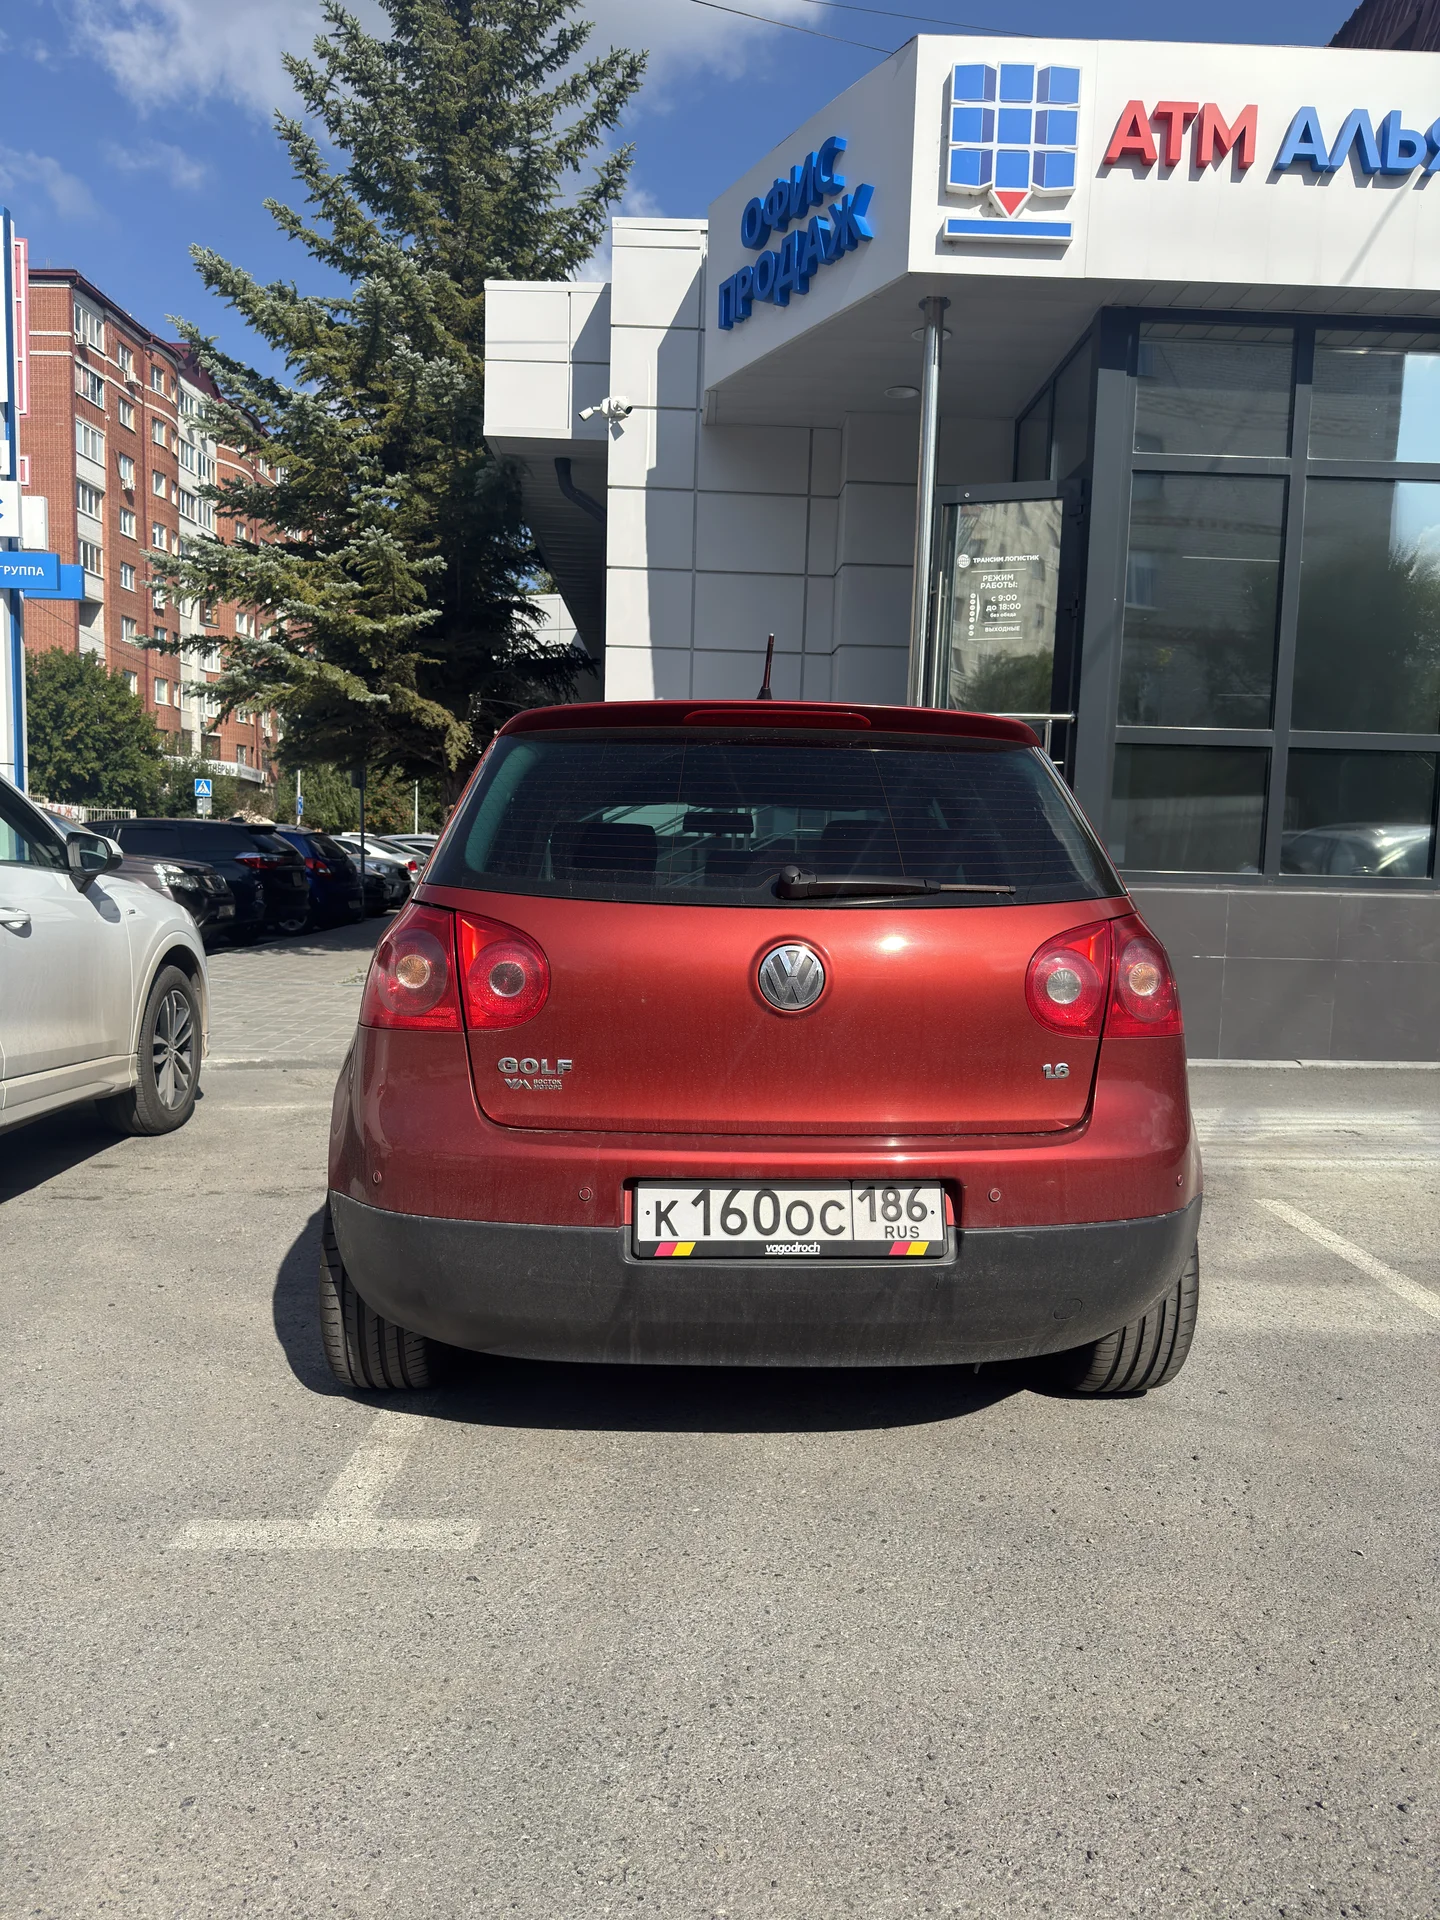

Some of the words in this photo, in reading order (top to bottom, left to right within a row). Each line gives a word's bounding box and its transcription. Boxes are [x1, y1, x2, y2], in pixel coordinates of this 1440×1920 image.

[1105, 101, 1258, 170] АТМ
[741, 136, 847, 250] ОФИС
[718, 183, 875, 330] ПРОДАЖ
[0, 565, 45, 576] РУППА
[980, 581, 1018, 589] РАБОТЫ:
[999, 602, 1021, 610] 18:00
[497, 1057, 572, 1075] GOLF
[857, 1186, 928, 1222] 186
[884, 1225, 920, 1239] RUS
[765, 1242, 821, 1255] vagodroch
